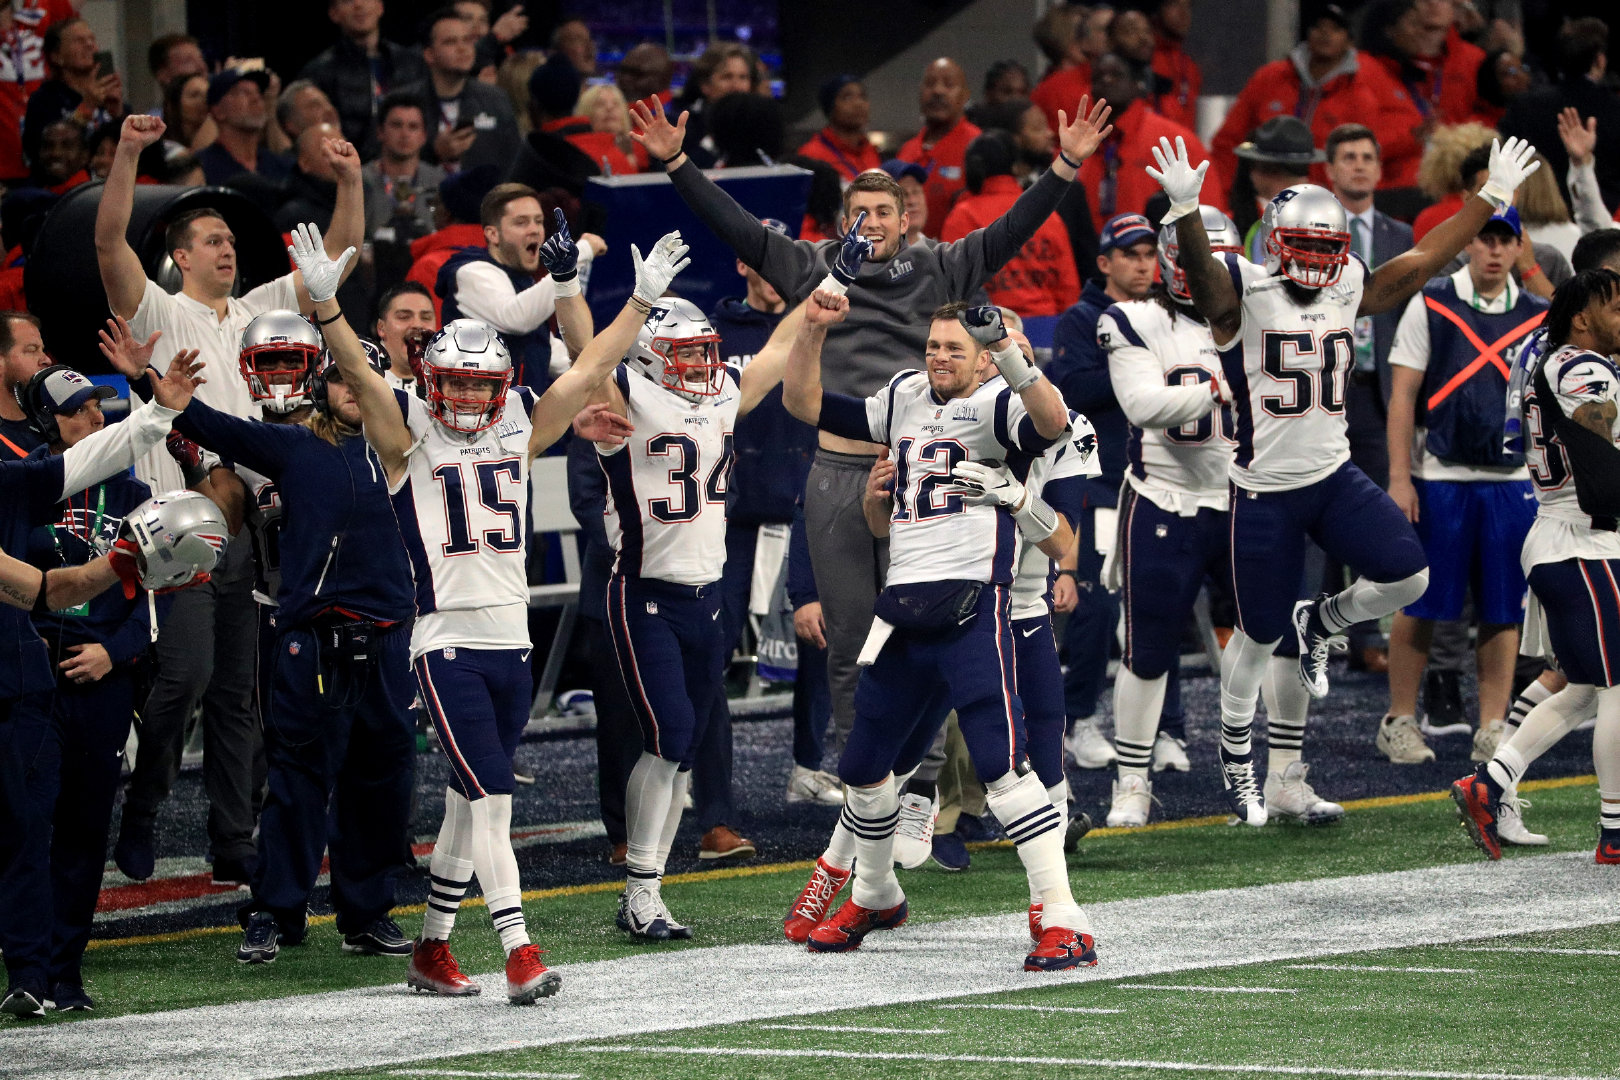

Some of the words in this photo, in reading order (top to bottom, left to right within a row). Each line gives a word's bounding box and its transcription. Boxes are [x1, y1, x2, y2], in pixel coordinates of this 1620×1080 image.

[1261, 328, 1355, 418] 50
[460, 447, 490, 456] PATRIOTS
[646, 432, 736, 524] 34
[890, 436, 969, 523] 12
[146, 517, 164, 536] 11
[432, 457, 522, 557] 15
